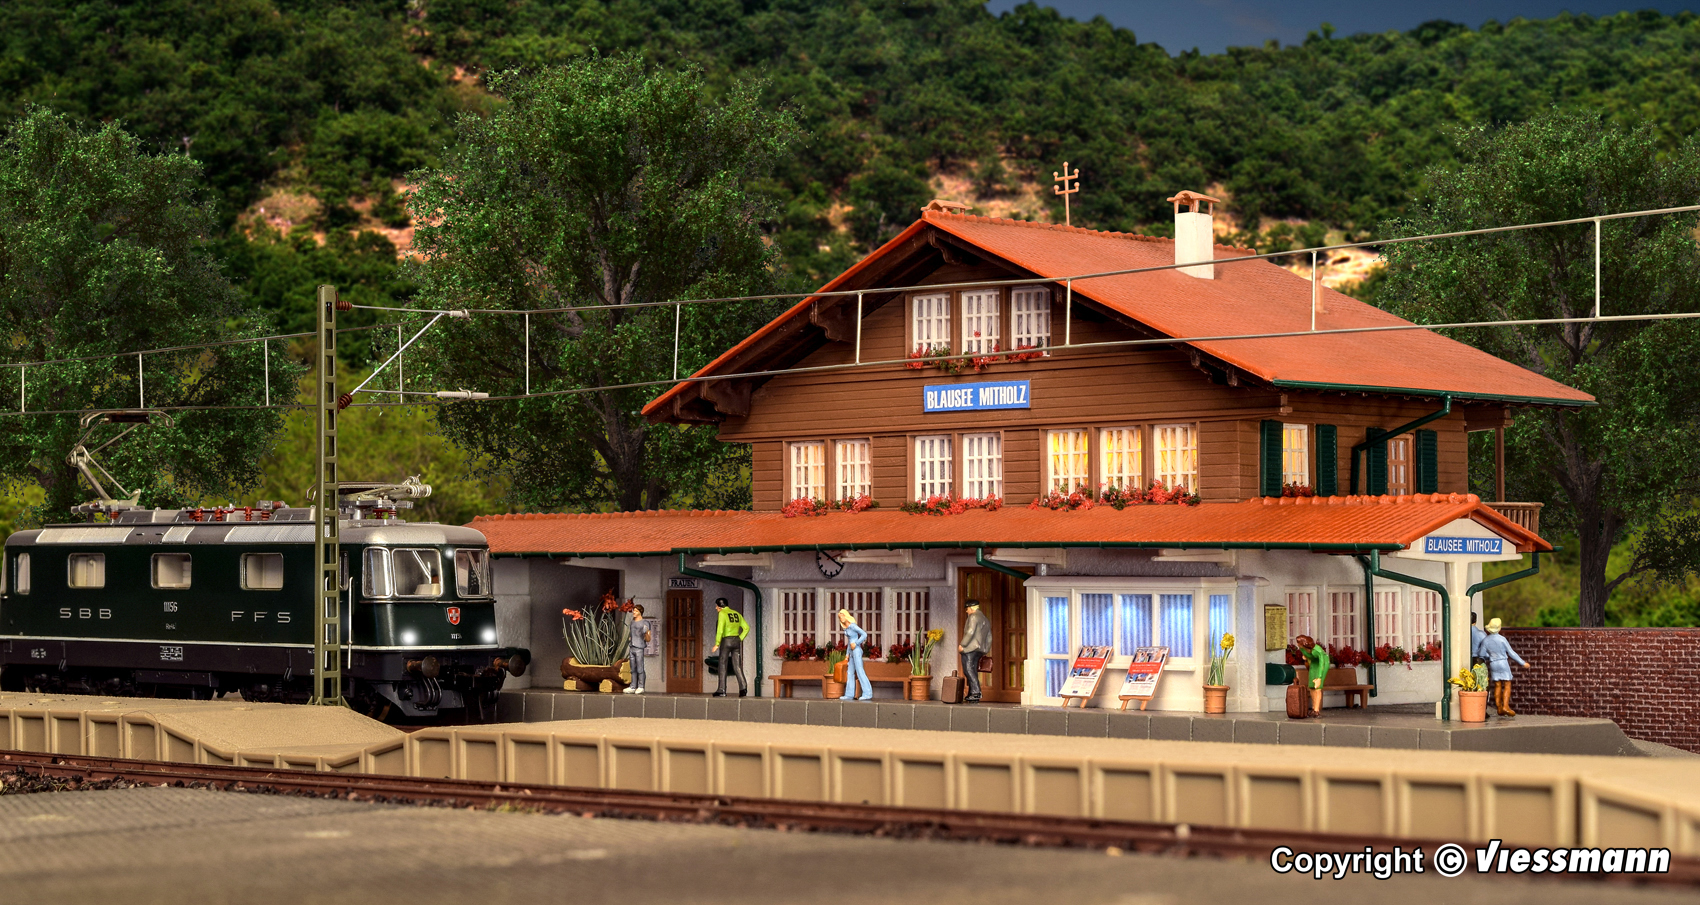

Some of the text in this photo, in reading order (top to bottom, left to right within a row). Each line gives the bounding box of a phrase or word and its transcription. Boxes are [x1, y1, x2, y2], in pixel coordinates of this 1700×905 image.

[926, 385, 1027, 409] BLAUSEE MITHOLZ
[1427, 539, 1500, 552] BLAUSEE MITHOLZ
[670, 579, 695, 587] FRAUEN
[727, 612, 740, 623] 69
